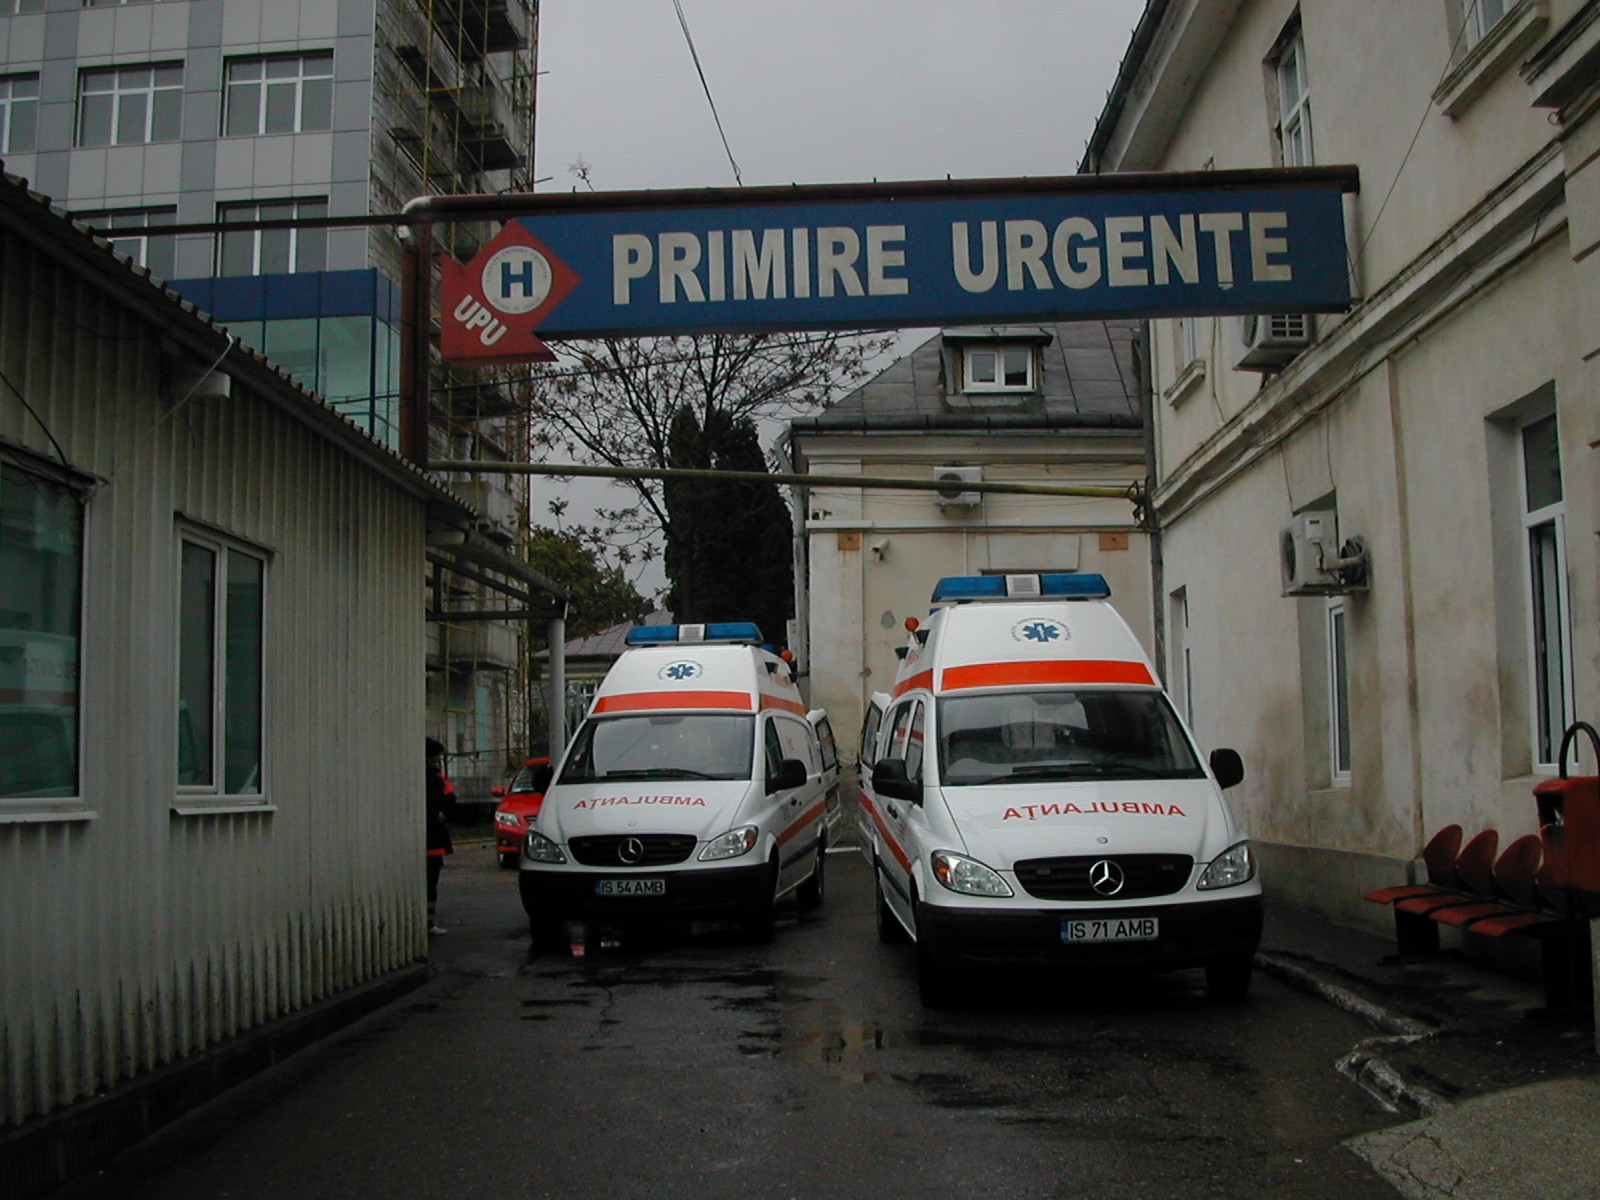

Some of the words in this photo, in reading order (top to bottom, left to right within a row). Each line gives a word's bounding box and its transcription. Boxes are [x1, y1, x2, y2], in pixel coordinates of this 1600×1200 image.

[501, 261, 533, 298] H
[612, 224, 910, 305] PRIMIRE
[453, 294, 508, 346] UPU
[601, 881, 613, 894] IS
[616, 881, 632, 894] 54
[634, 881, 664, 894] AMB
[1069, 921, 1086, 939] IS
[1092, 920, 1109, 938] 71
[1115, 918, 1155, 937] AMB
